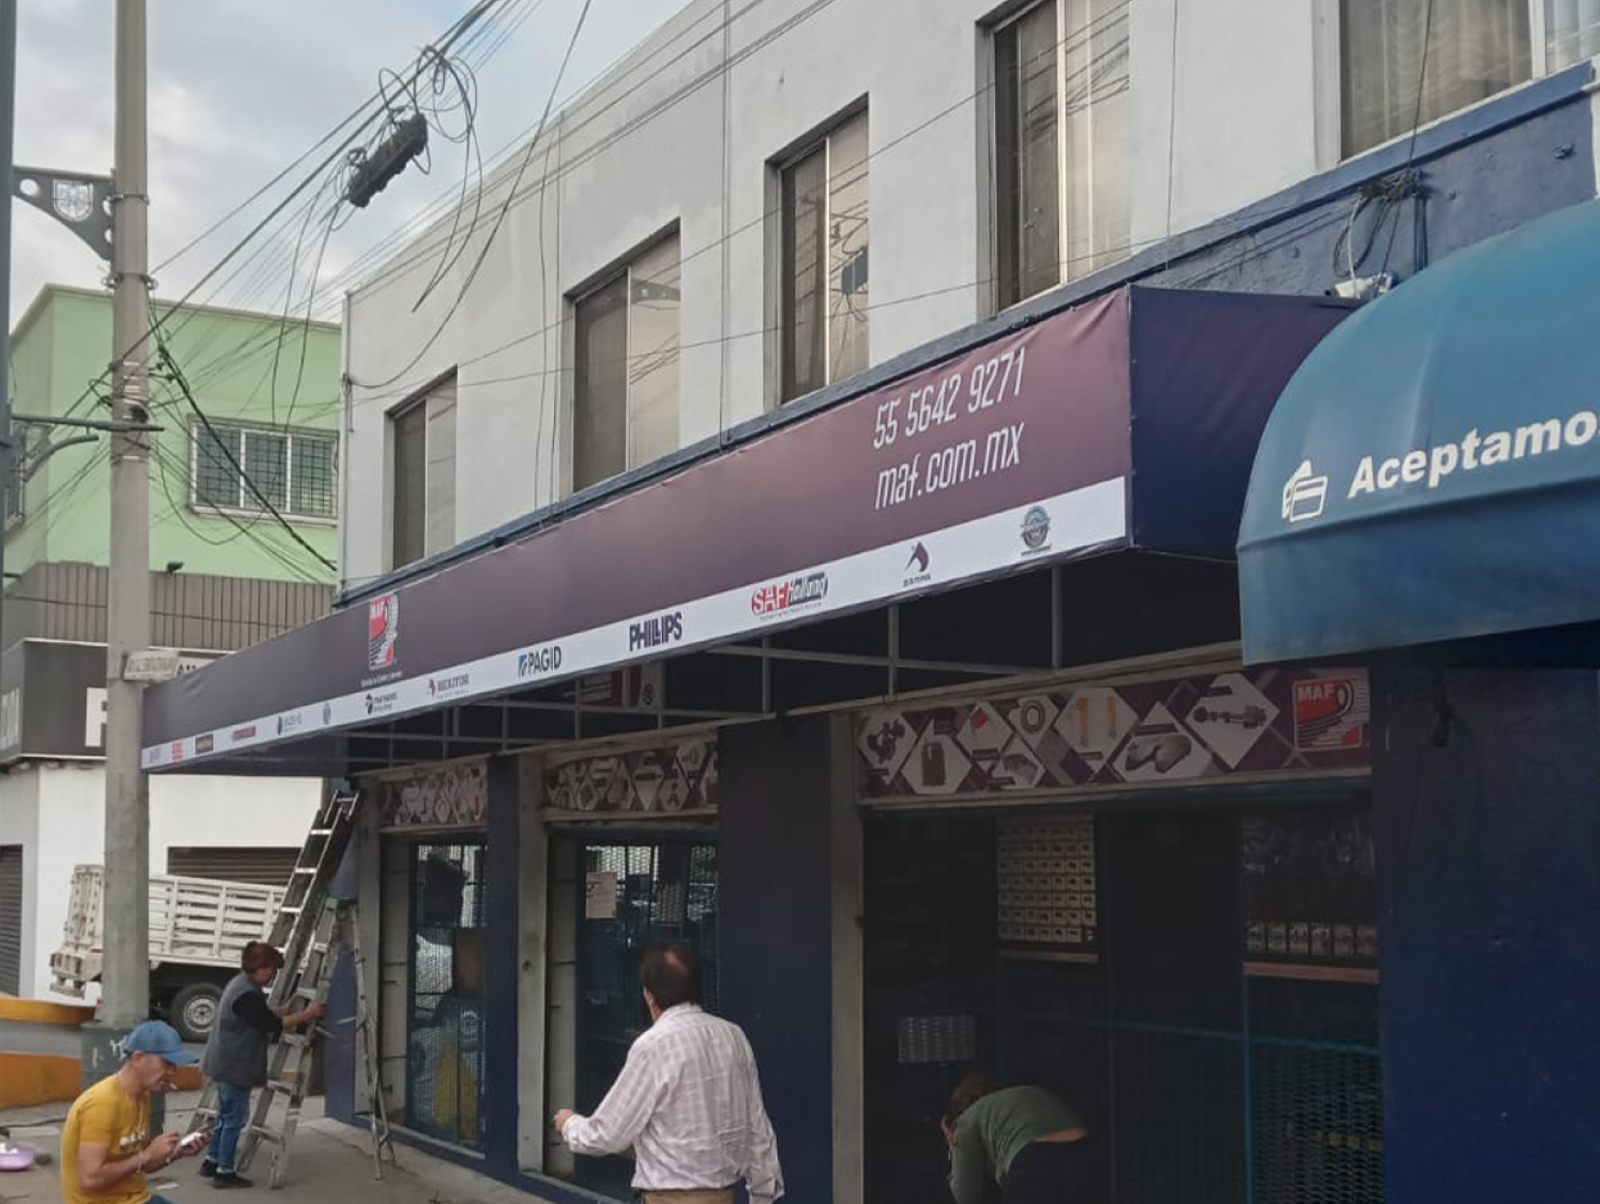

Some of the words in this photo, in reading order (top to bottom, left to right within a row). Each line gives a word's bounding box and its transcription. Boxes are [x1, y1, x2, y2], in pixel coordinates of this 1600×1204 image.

[874, 398, 901, 449] 55
[905, 373, 963, 437] 5642
[968, 347, 1026, 413] 9271
[874, 422, 1025, 510] maf.com.mx
[1347, 410, 1600, 499] Aceptamo
[527, 646, 562, 675] PAGID
[629, 611, 683, 652] PHILLIPS
[1297, 683, 1334, 700] MAF
